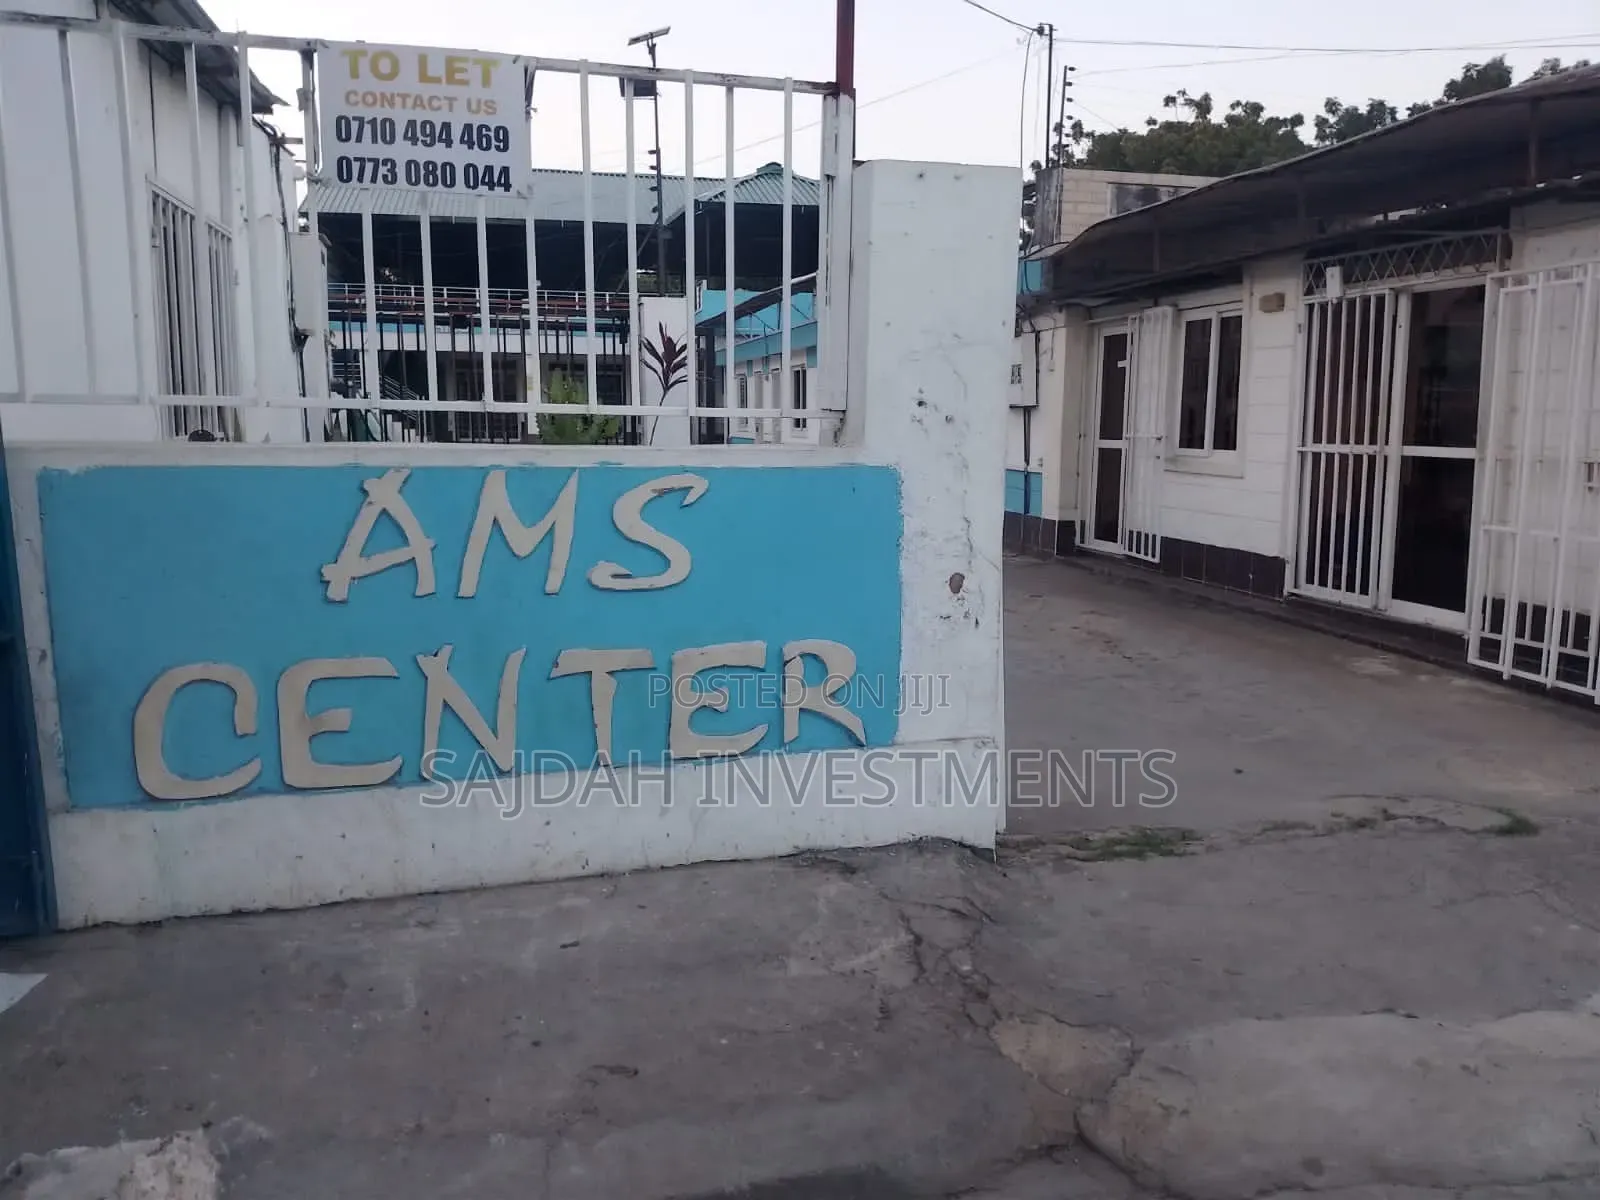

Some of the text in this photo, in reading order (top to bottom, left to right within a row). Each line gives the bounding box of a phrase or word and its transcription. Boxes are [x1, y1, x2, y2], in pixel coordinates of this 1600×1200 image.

[340, 49, 499, 88] TO LET
[344, 89, 498, 115] CONTACT US
[335, 115, 510, 152] 0710 494 469
[336, 156, 512, 192] 0773 080 044
[321, 466, 709, 602] AMS
[133, 638, 867, 802] CENTER
